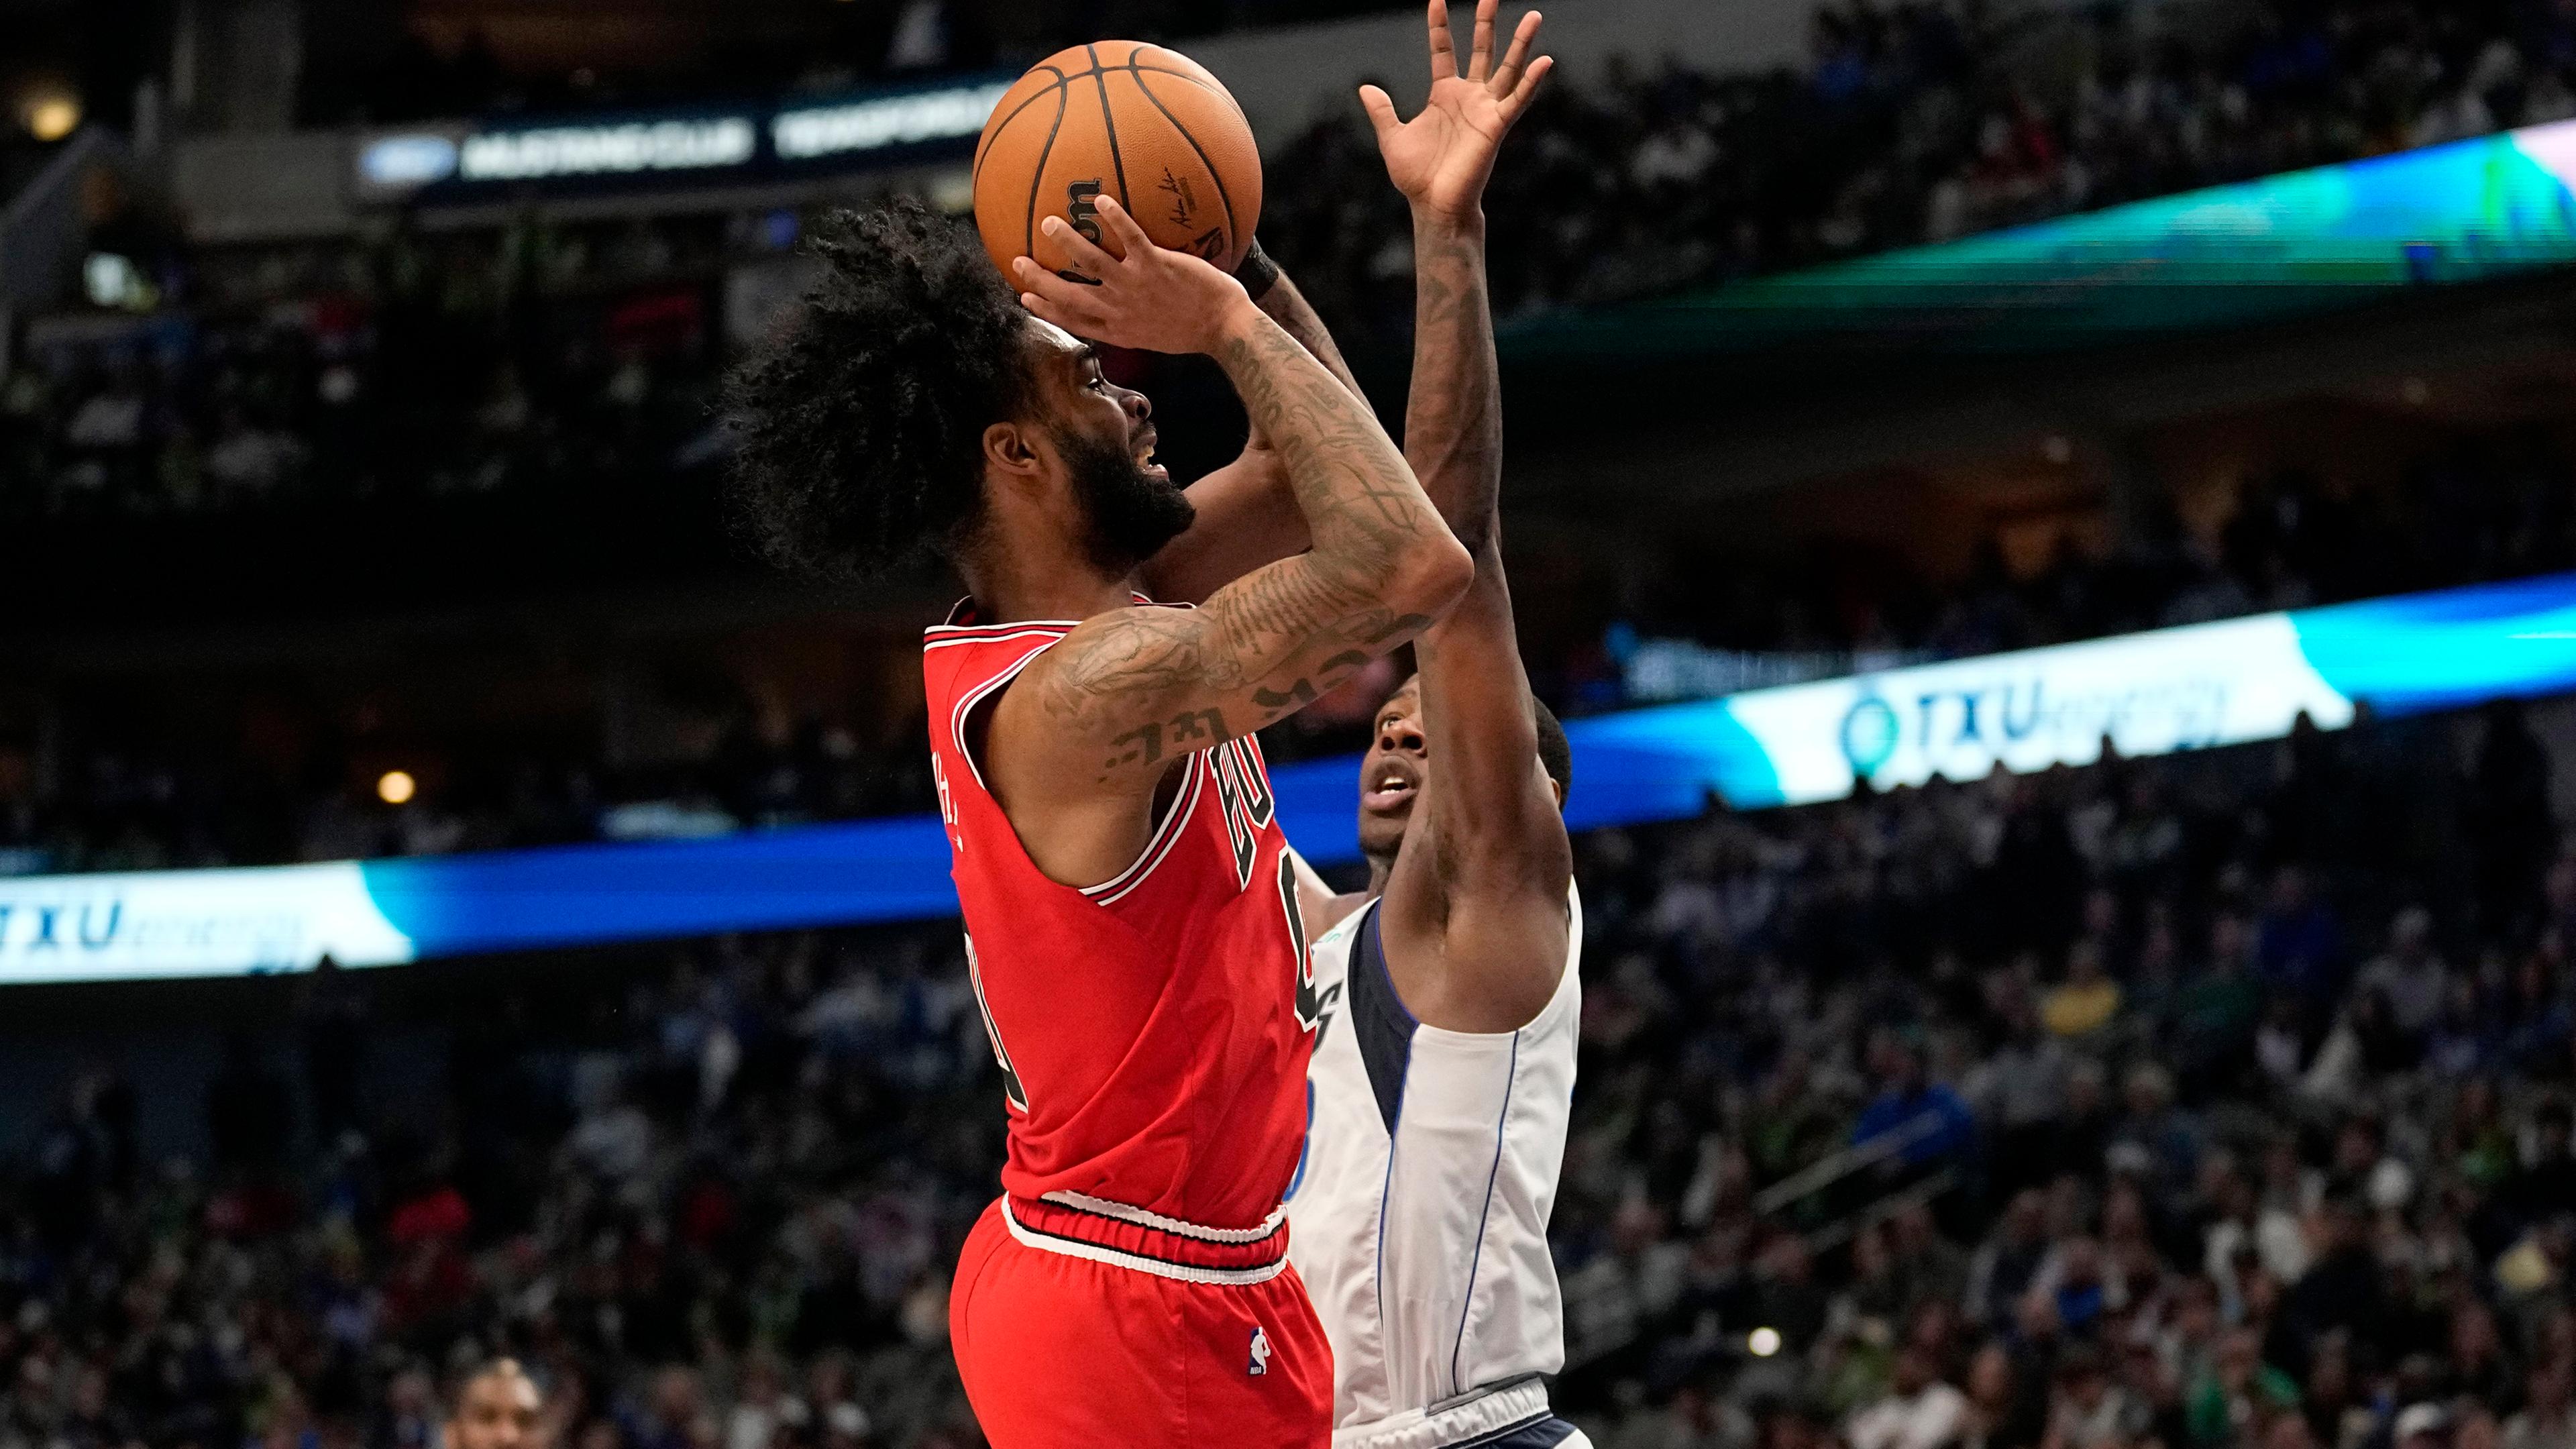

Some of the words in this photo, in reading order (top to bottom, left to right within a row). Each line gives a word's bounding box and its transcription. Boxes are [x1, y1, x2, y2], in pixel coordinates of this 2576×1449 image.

[651, 118, 754, 170] CLUB
[1917, 676, 2045, 747] TXU
[1250, 1366, 1262, 1375] NBA
